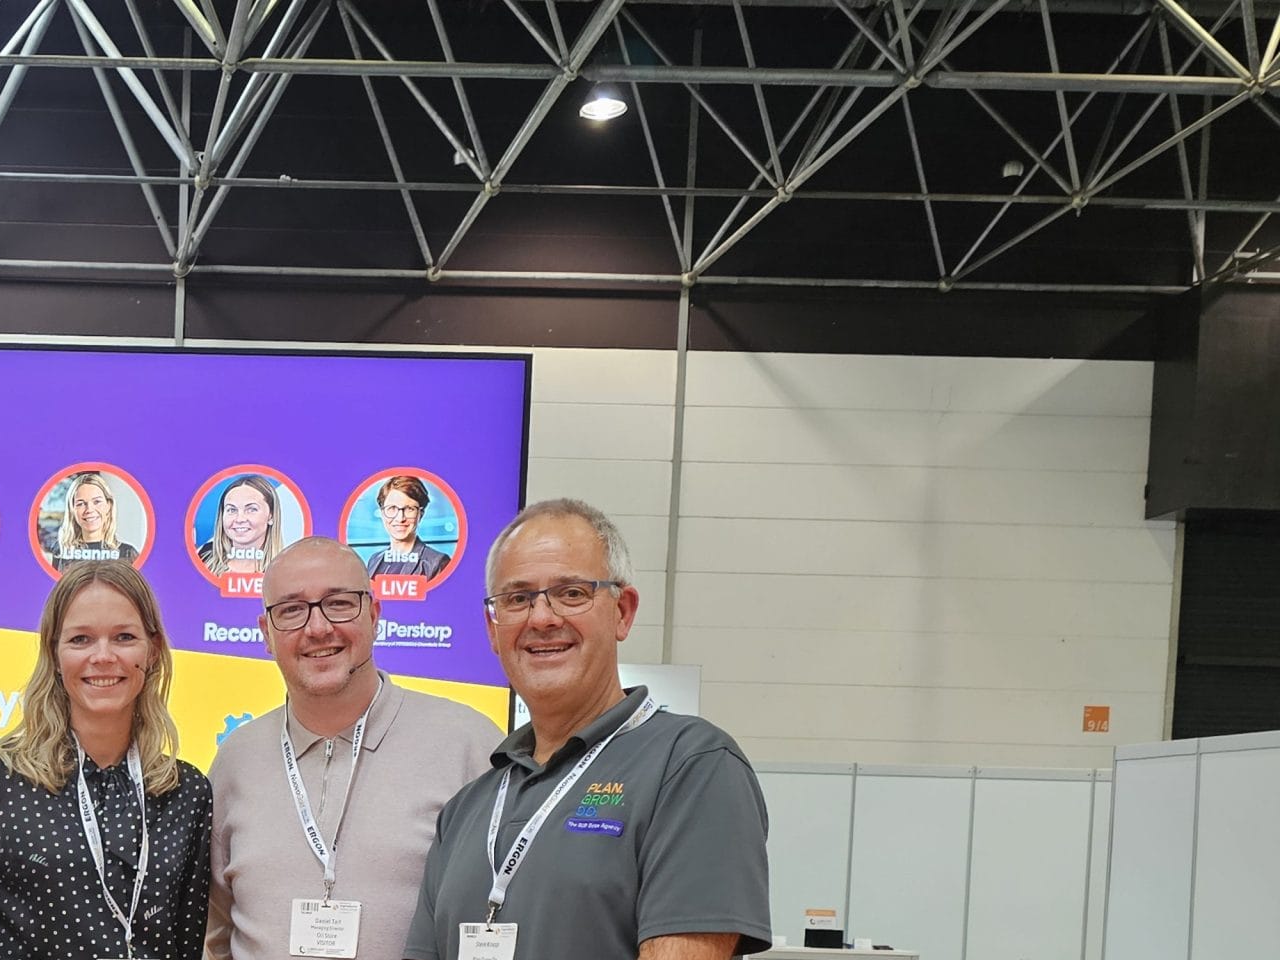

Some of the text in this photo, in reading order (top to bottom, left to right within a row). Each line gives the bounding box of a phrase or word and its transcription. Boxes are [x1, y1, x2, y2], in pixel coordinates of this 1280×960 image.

[62, 547, 120, 561] Lisanne
[227, 547, 264, 560] Jade
[383, 549, 419, 563] Elisa
[228, 577, 263, 593] LIVE
[381, 580, 417, 596] LIVE
[387, 621, 452, 642] Perstorp
[283, 741, 294, 772] ERGON
[80, 790, 92, 822] ERGON
[307, 825, 325, 857] ERGON
[504, 836, 528, 876] ERGON
